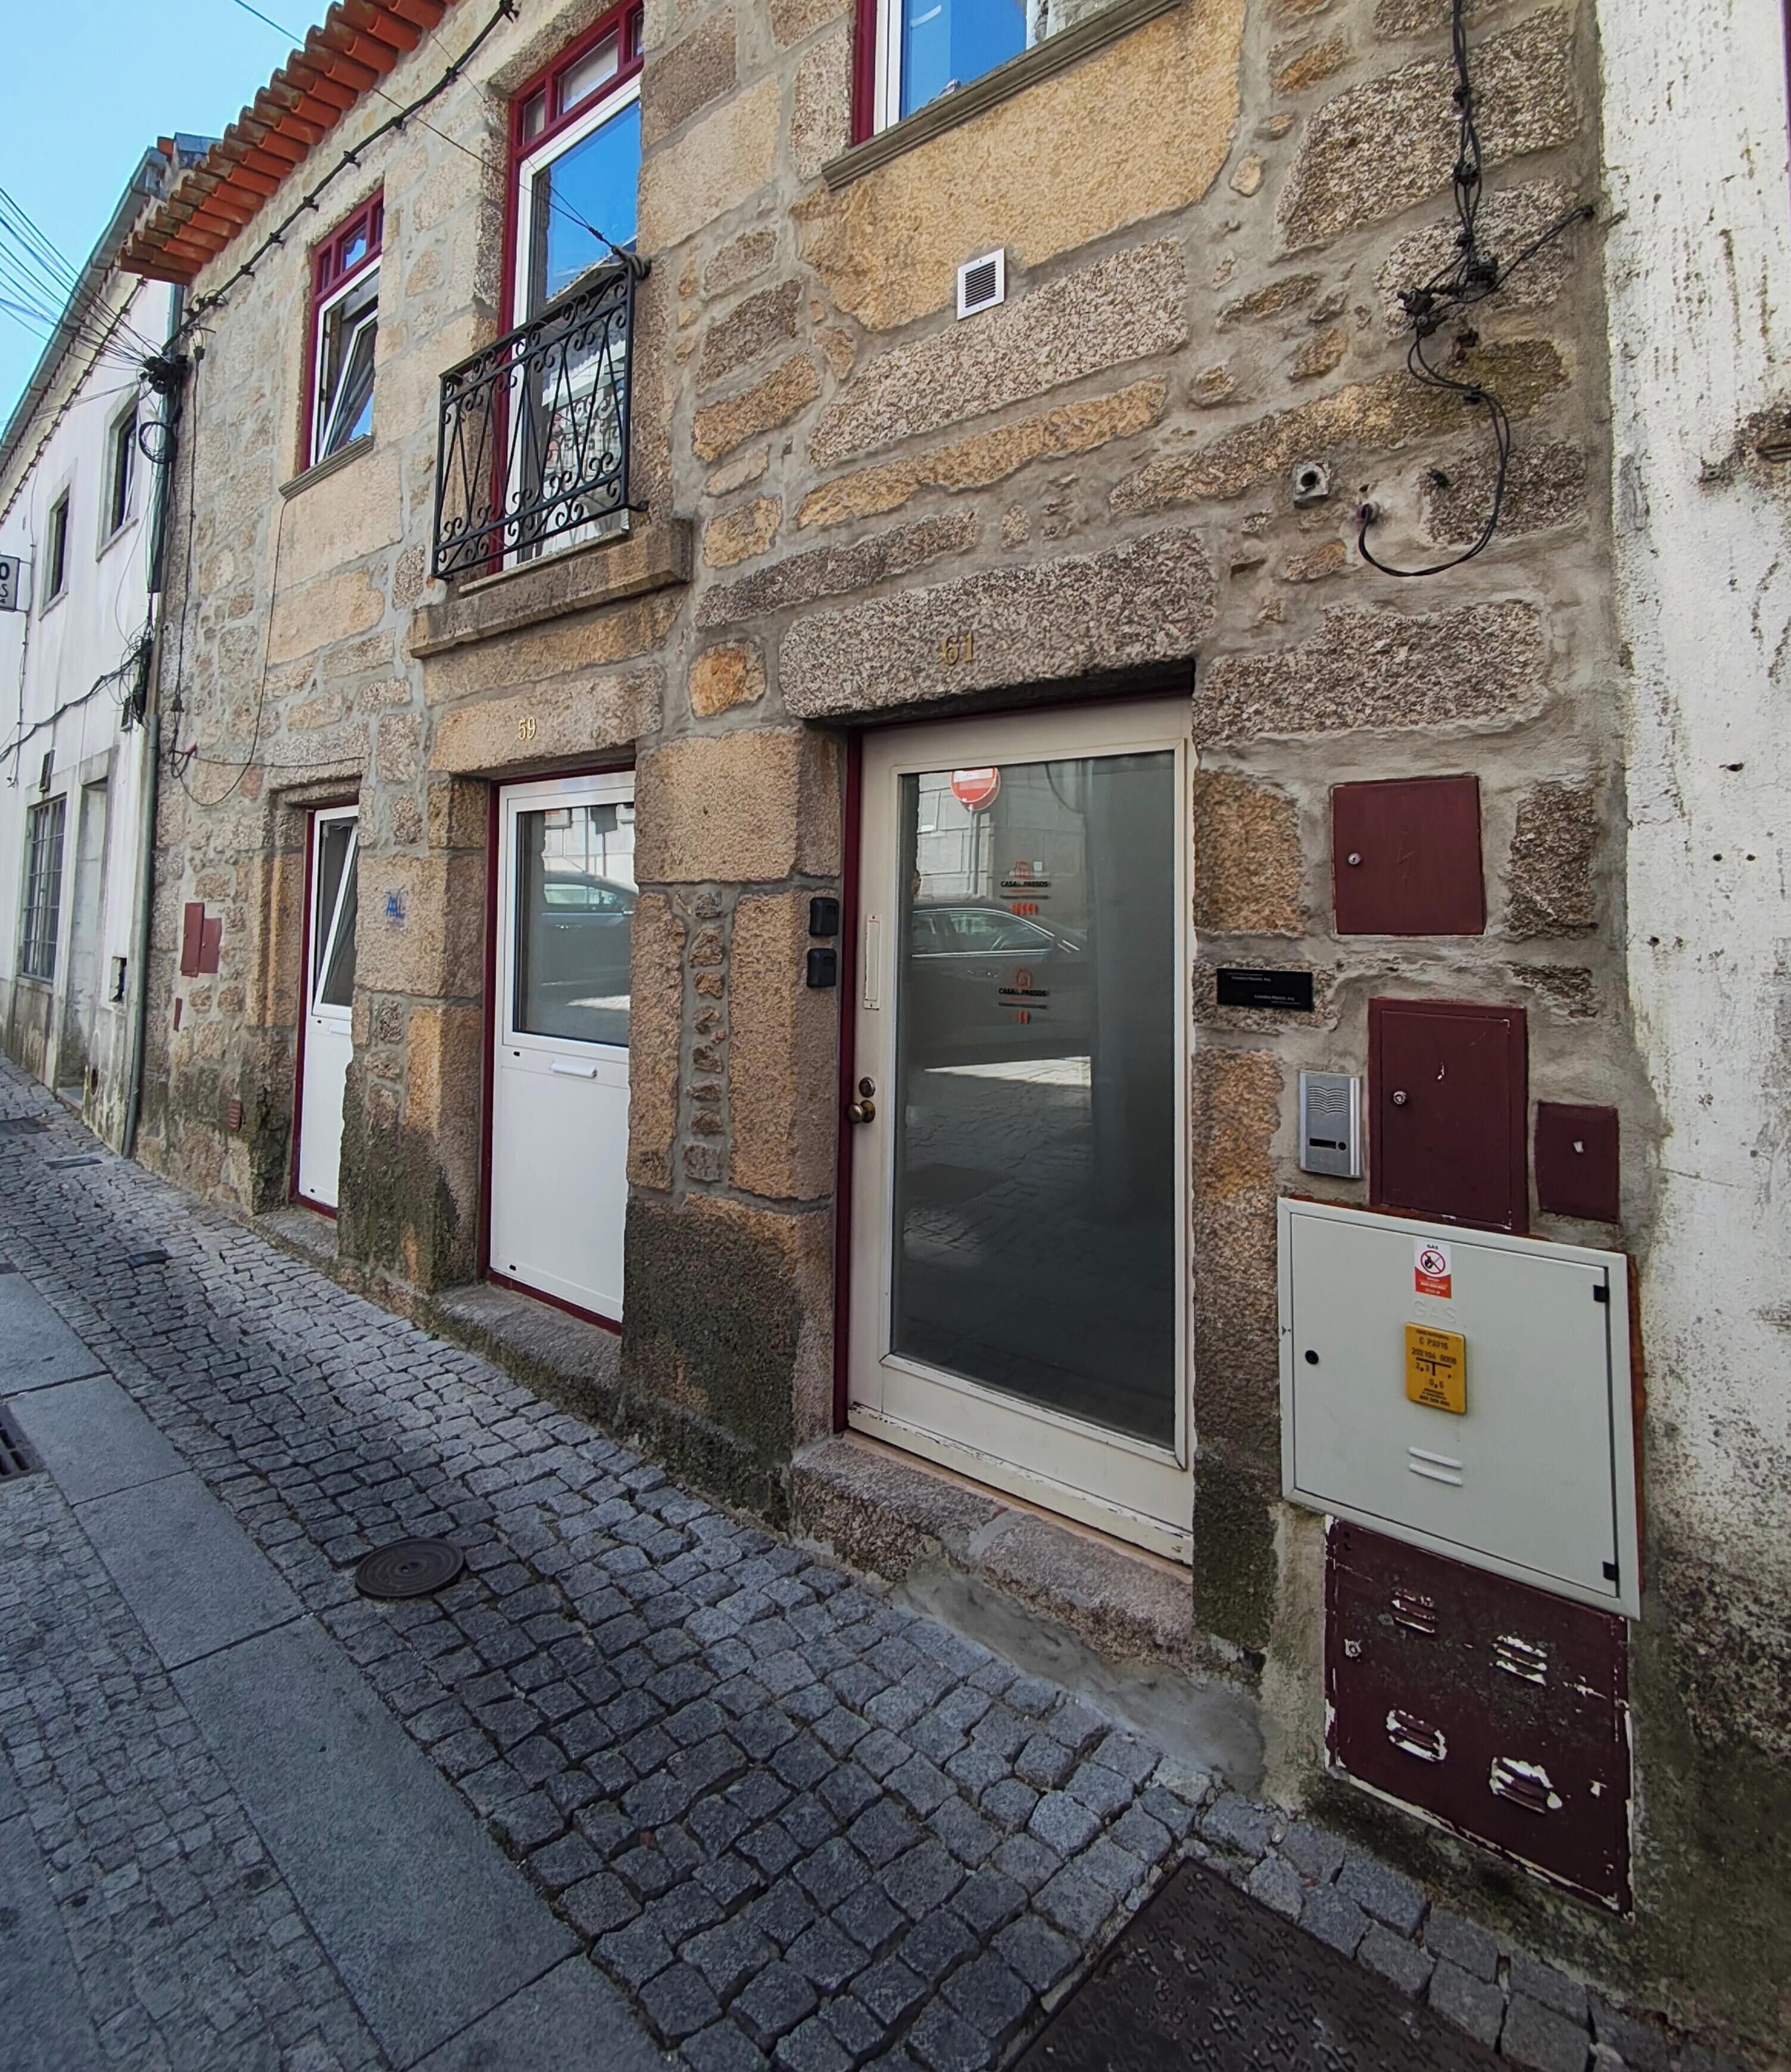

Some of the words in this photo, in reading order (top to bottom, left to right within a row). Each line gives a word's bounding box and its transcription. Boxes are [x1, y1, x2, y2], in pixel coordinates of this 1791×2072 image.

[940, 630, 975, 666] 61
[518, 716, 536, 741] 59
[1414, 1300, 1457, 1323] GAS
